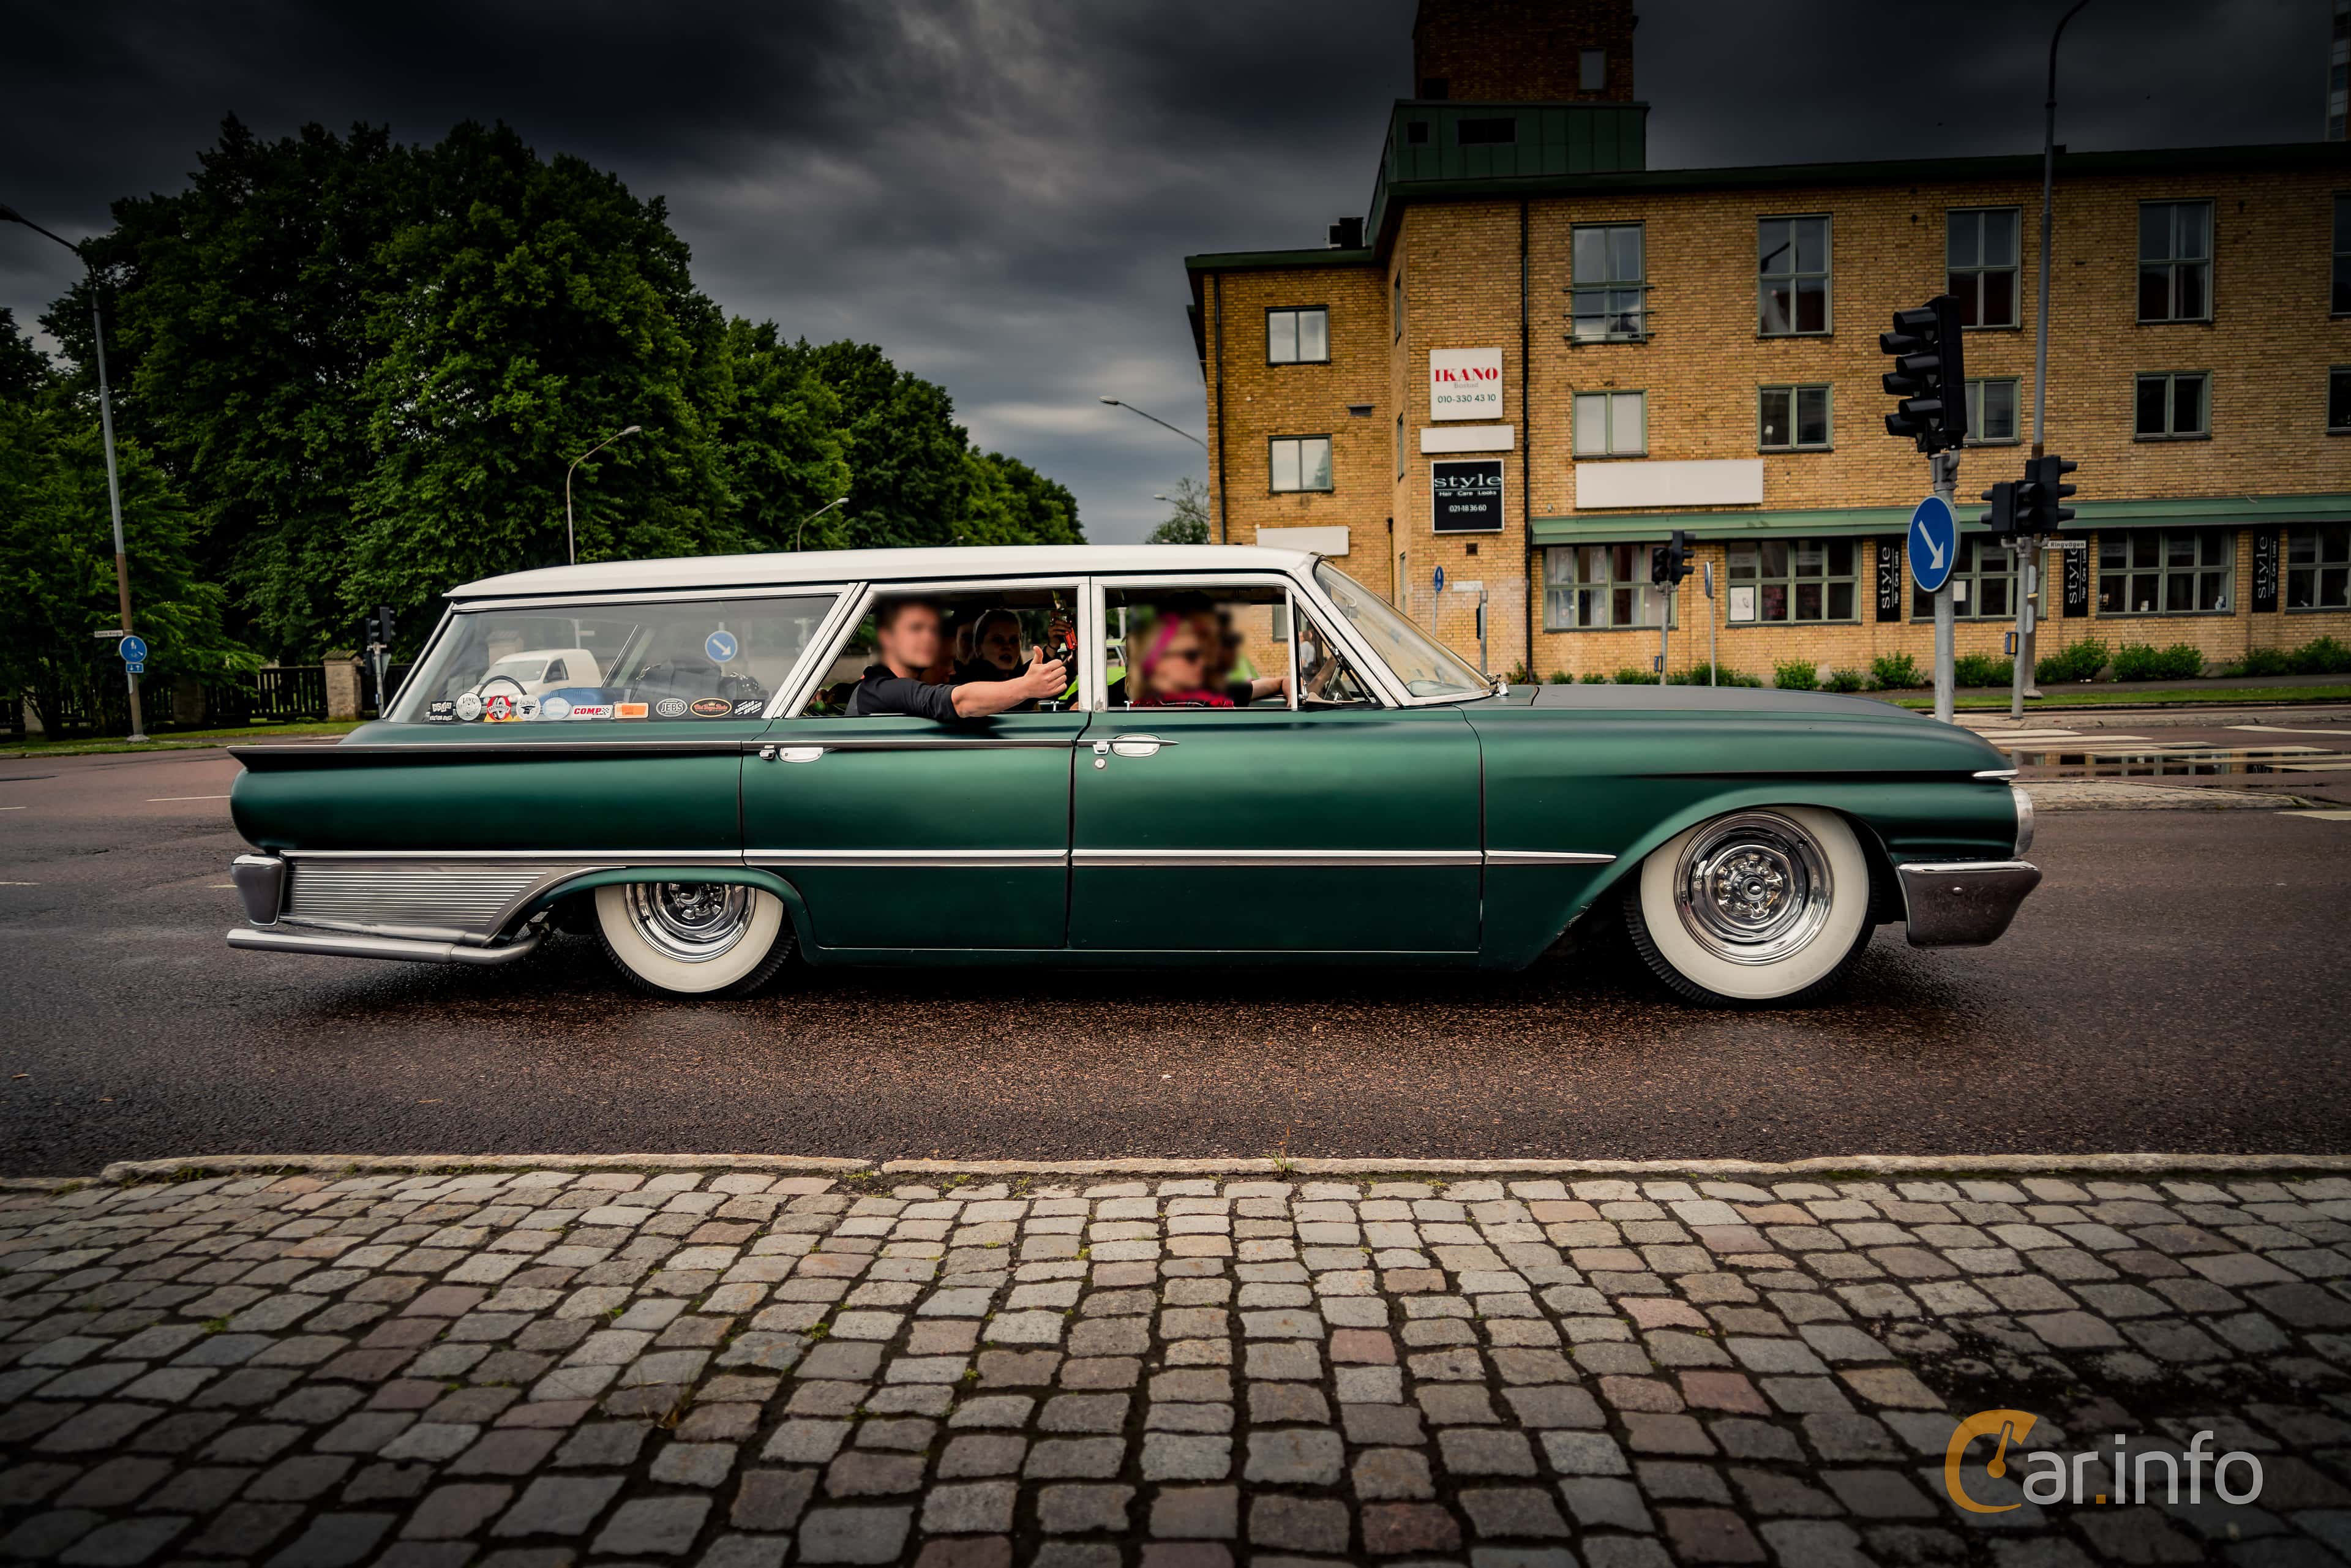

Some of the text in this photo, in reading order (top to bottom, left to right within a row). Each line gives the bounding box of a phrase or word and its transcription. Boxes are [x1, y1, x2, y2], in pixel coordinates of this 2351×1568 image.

[1434, 367, 1498, 381] IKANO
[1438, 394, 1472, 403] 010-330
[1434, 473, 1502, 488] style
[2255, 536, 2268, 599] style
[1879, 546, 1892, 609] style
[661, 702, 683, 712] JEBS
